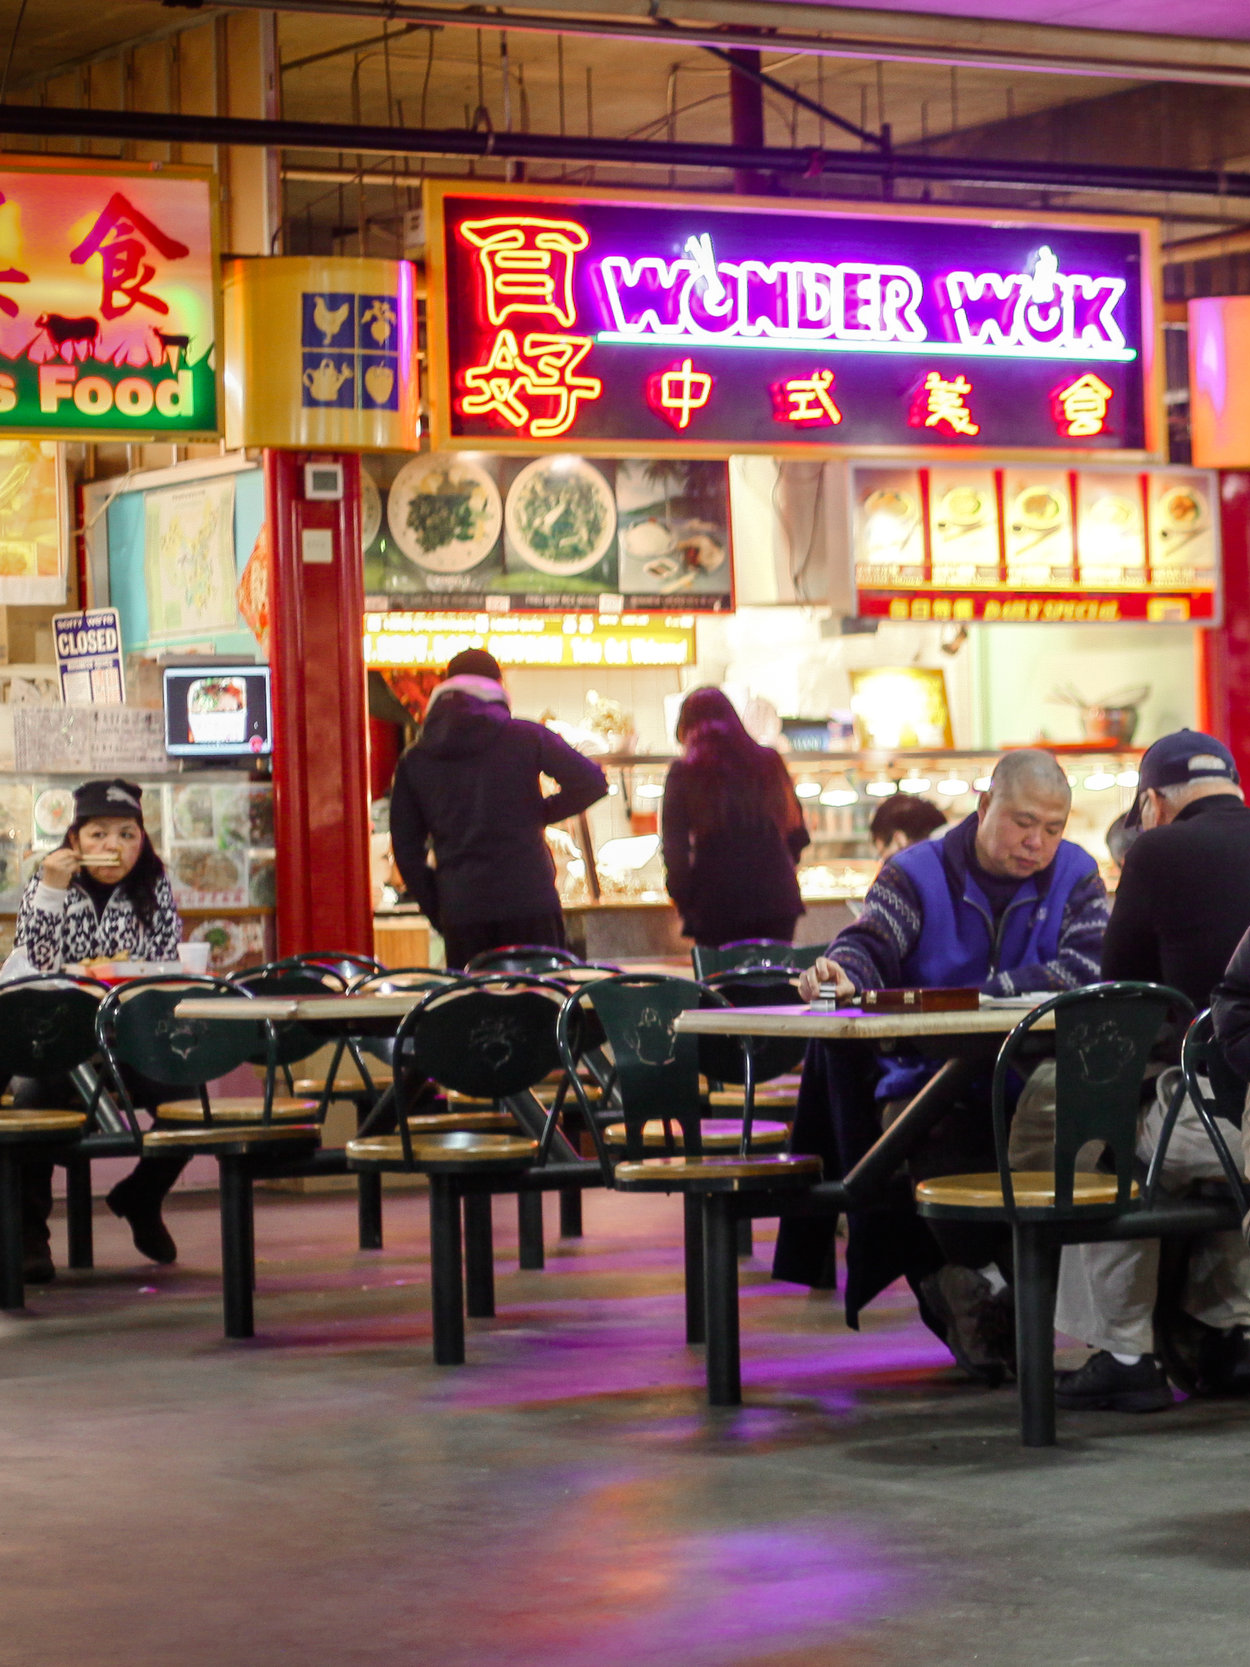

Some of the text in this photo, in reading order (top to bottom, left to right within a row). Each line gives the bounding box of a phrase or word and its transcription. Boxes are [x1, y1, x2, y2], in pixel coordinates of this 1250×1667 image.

[0, 191, 190, 320] 食
[601, 240, 1128, 351] WONDER WOK
[38, 364, 195, 418] Food
[659, 358, 1114, 437] 中式美食
[58, 627, 117, 657] CLOSED
